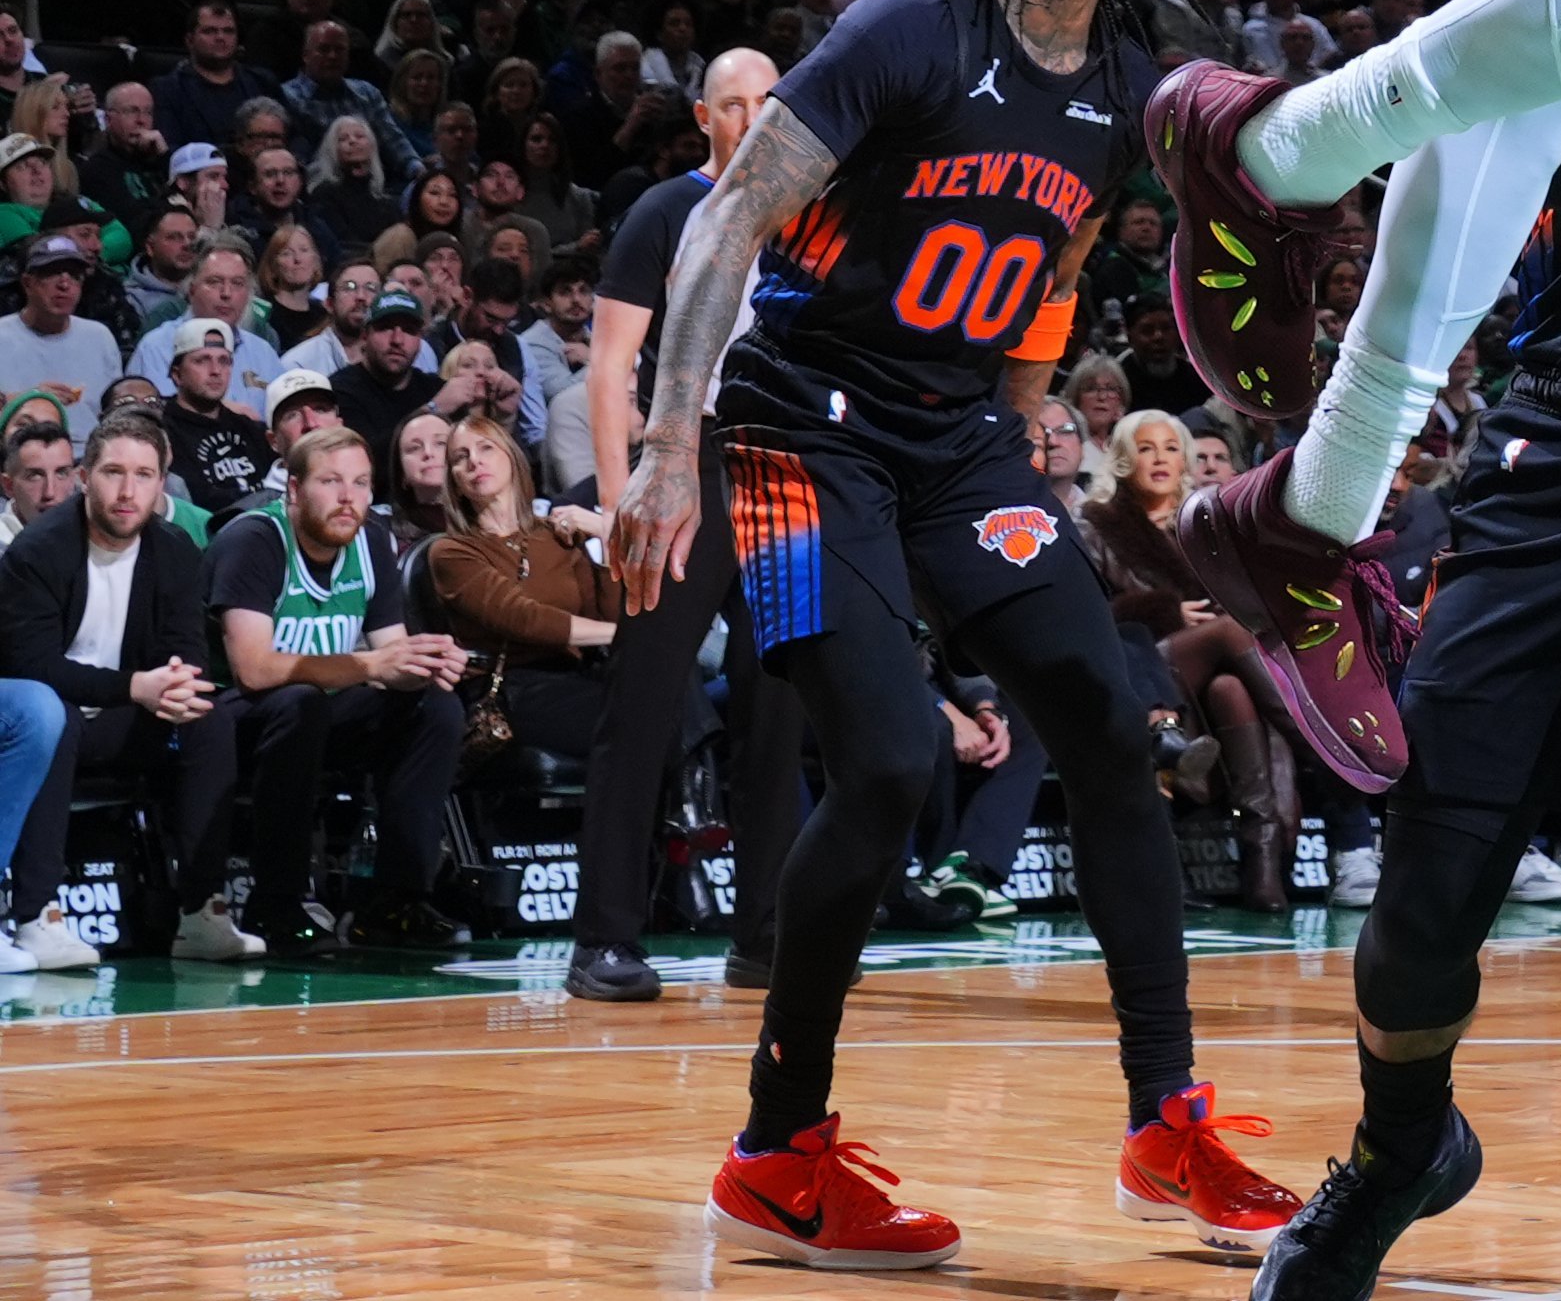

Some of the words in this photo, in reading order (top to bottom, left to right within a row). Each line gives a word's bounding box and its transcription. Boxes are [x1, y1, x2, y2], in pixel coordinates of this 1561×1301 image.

[903, 152, 1019, 199] NEW
[1013, 152, 1095, 237] YORK
[890, 219, 1048, 344] 00
[520, 862, 580, 892] OST
[57, 883, 121, 913] TON
[517, 891, 578, 922] CELT
